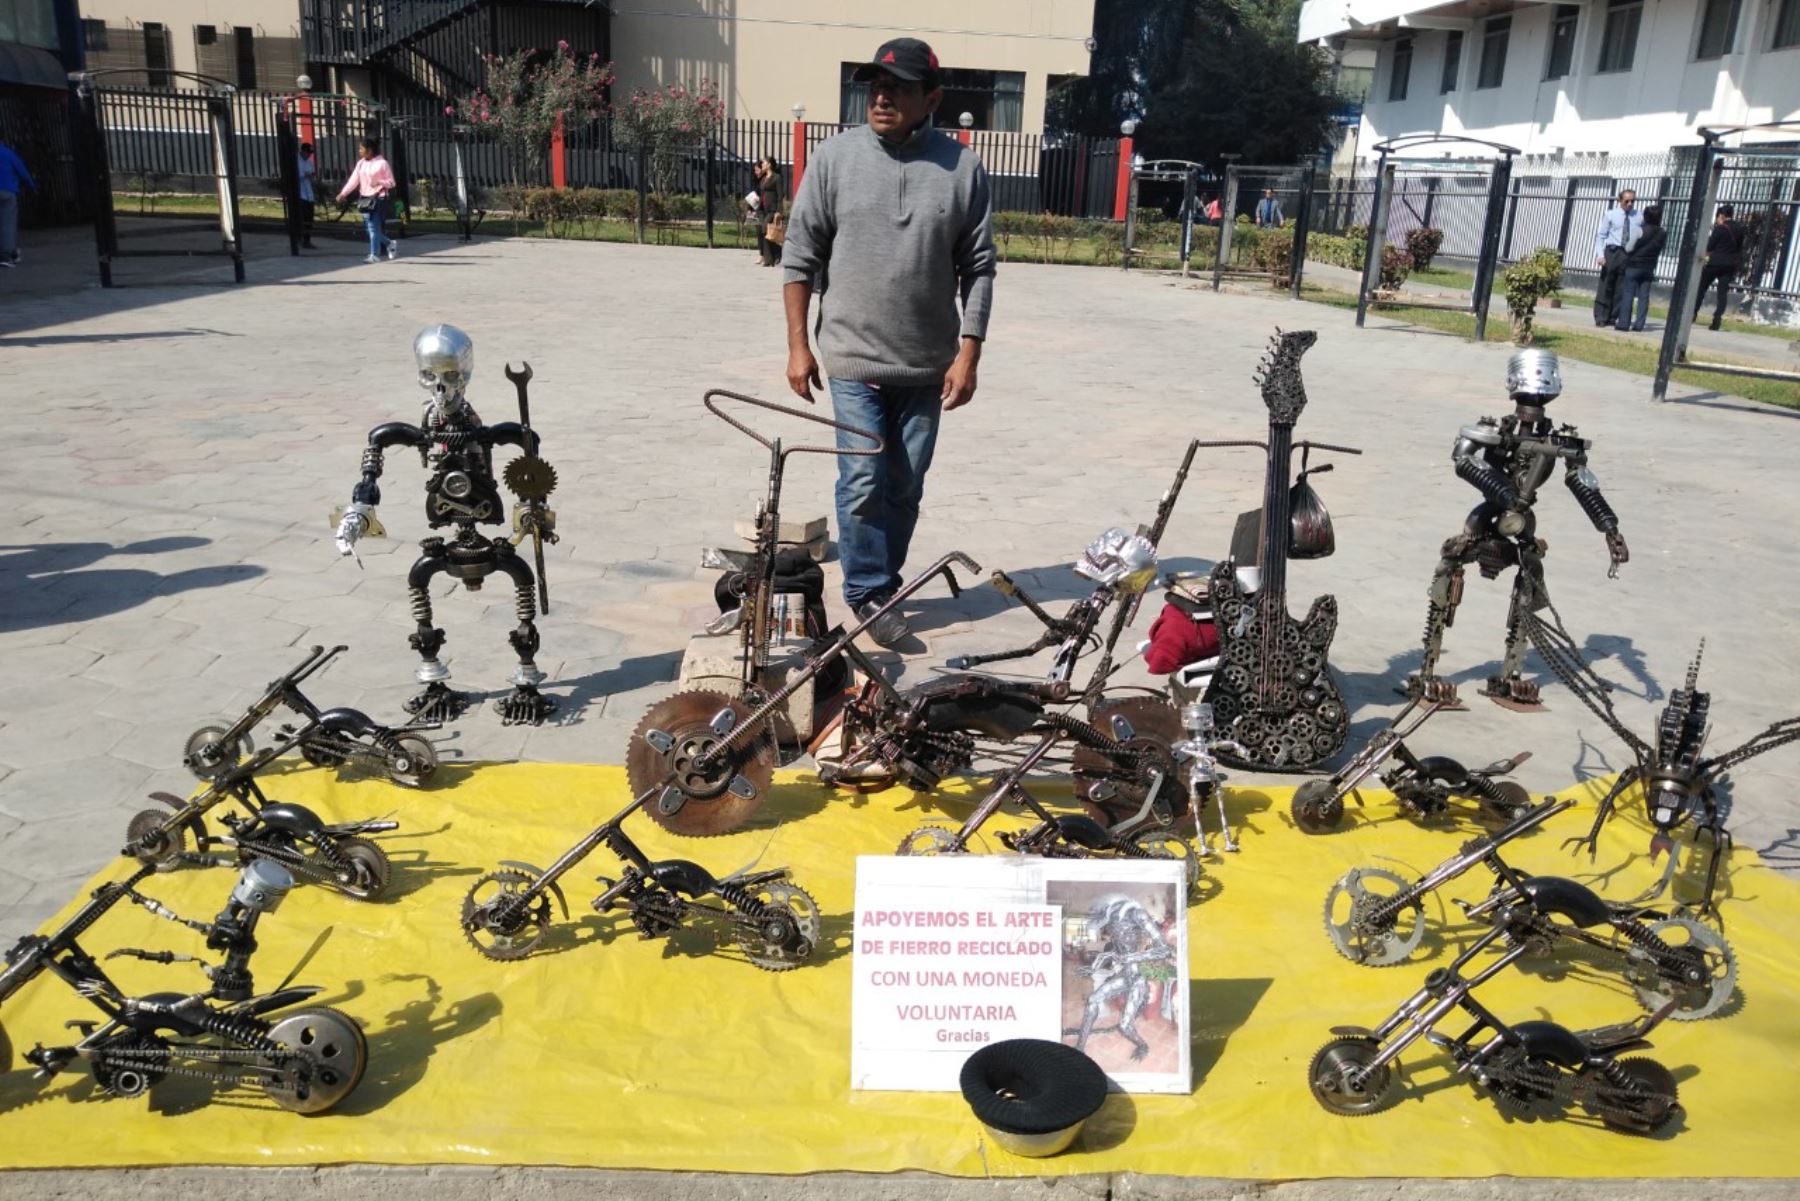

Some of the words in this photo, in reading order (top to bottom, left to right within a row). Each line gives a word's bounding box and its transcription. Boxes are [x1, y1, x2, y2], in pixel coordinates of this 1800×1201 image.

[861, 911, 970, 928] APOYEMOS
[976, 912, 997, 927] EL
[1004, 912, 1053, 927] ARTE
[861, 940, 884, 955] DE
[889, 941, 952, 955] FIERRO
[957, 941, 1053, 956] RECICLADO
[871, 971, 910, 987] CON
[916, 971, 957, 987] UNA
[963, 971, 1047, 987] MONEDA
[896, 1005, 1017, 1021] VOLUNTARIA
[936, 1029, 990, 1042] Gracias
